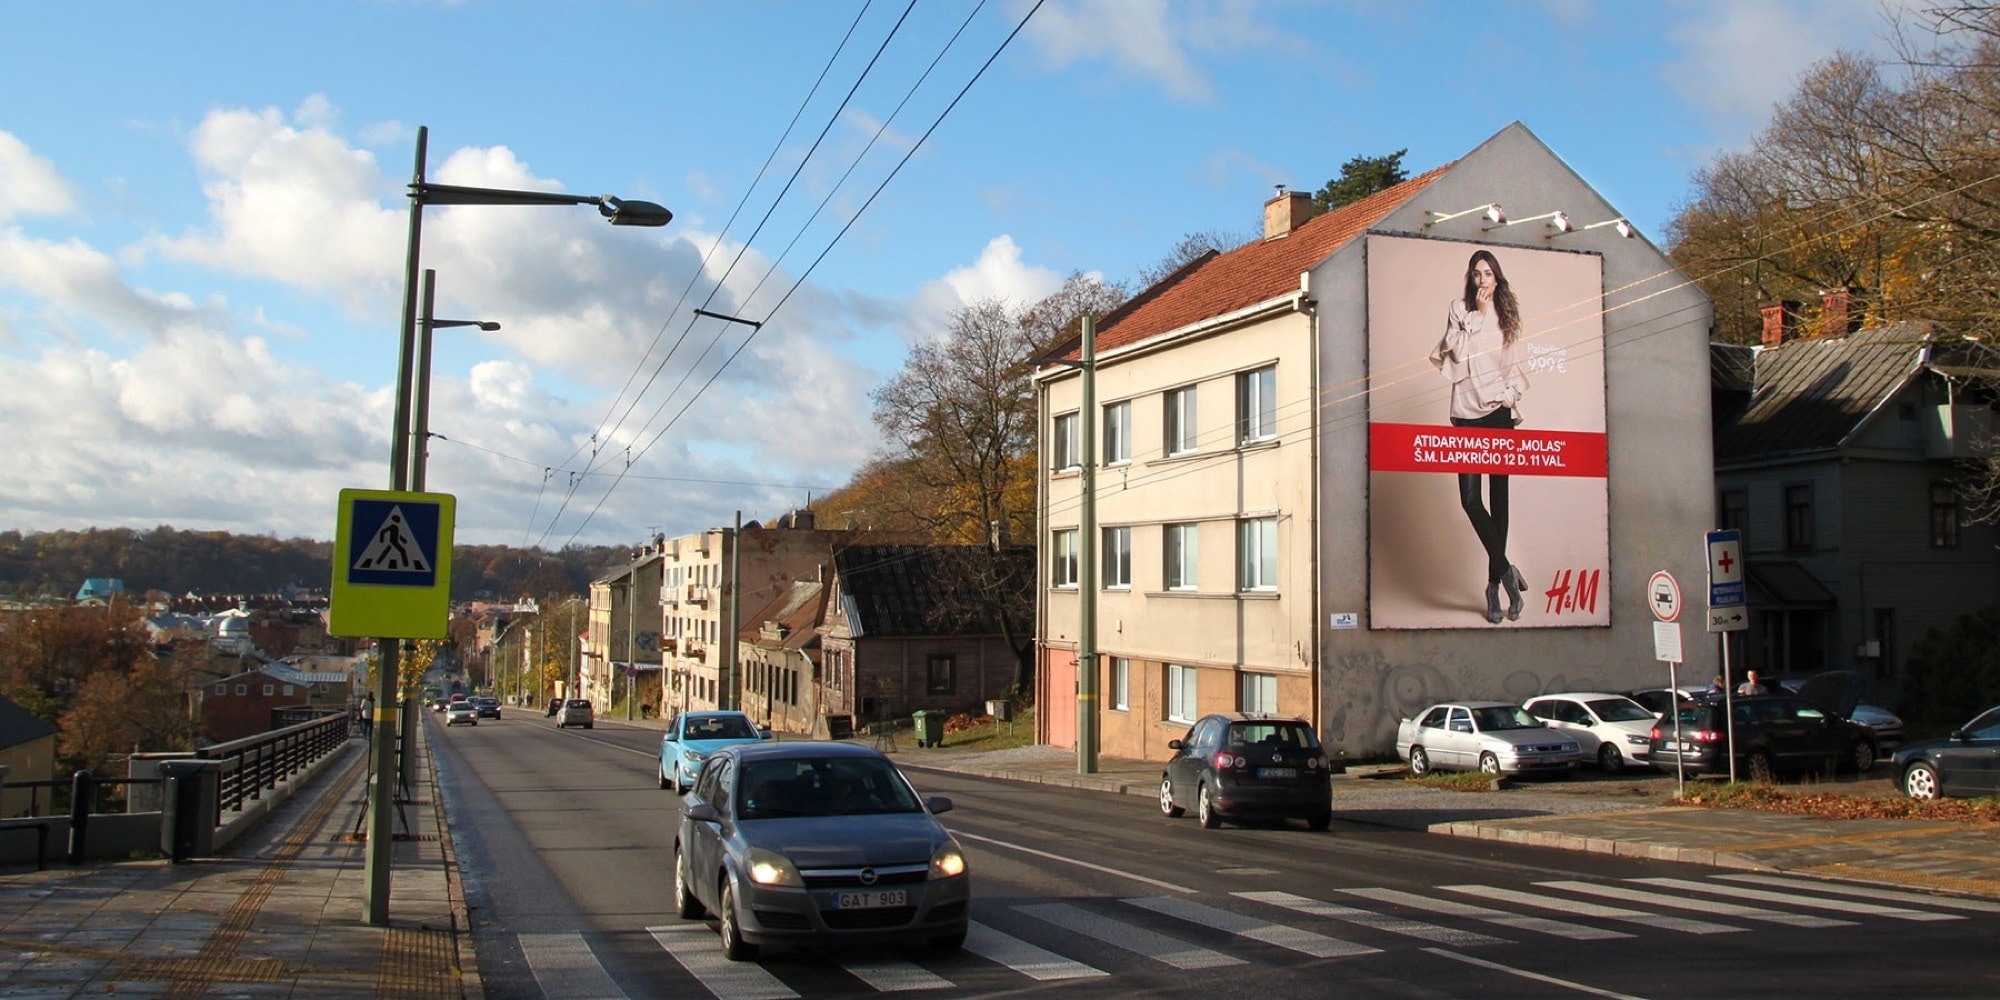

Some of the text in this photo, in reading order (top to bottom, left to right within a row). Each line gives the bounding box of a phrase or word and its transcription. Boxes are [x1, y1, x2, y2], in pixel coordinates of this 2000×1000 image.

[1413, 434, 1490, 450] ATIDARYMAS
[1492, 438, 1515, 451] PPC
[1414, 447, 1566, 467] Š.M. LAPKRIČIO 12 D. 11 VAL.
[1545, 568, 1600, 616] H&M
[840, 891, 904, 908] GAT 903
